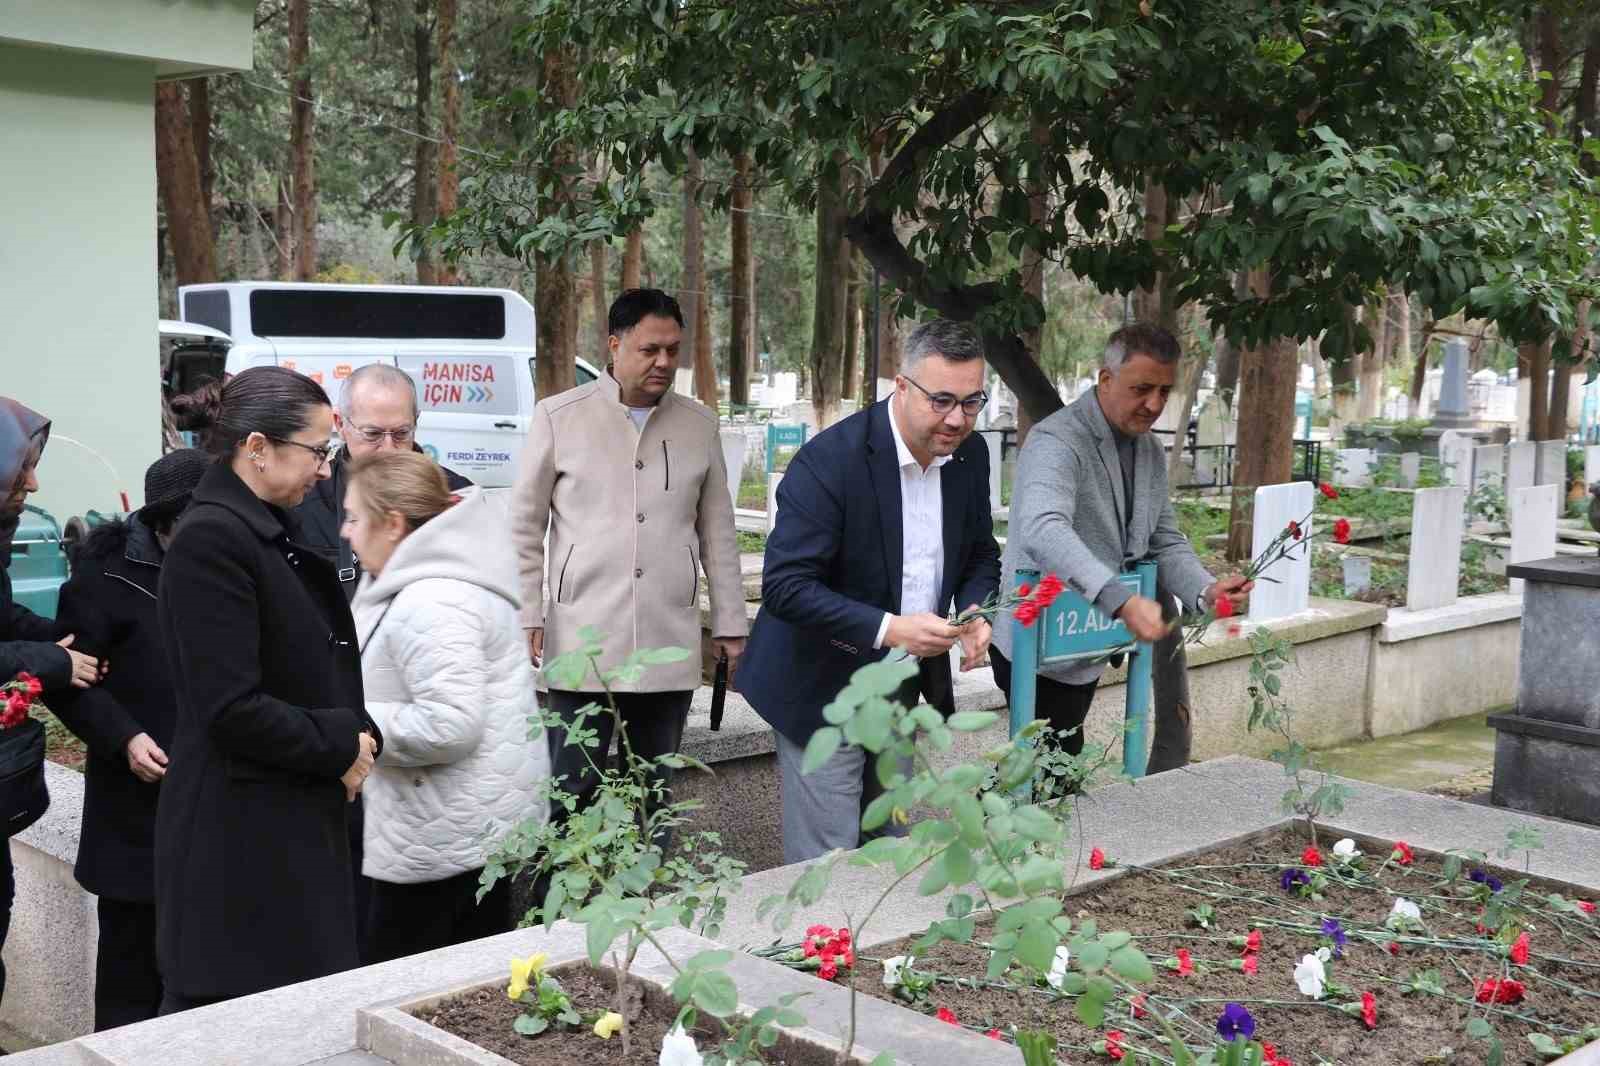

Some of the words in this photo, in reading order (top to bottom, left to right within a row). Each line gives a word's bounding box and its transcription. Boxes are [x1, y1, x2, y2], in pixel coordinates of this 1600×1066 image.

[423, 363, 495, 382] MANİSA
[424, 384, 462, 406] İÇİN
[475, 452, 511, 462] ZEYREK
[1056, 607, 1126, 637] 12.AD
